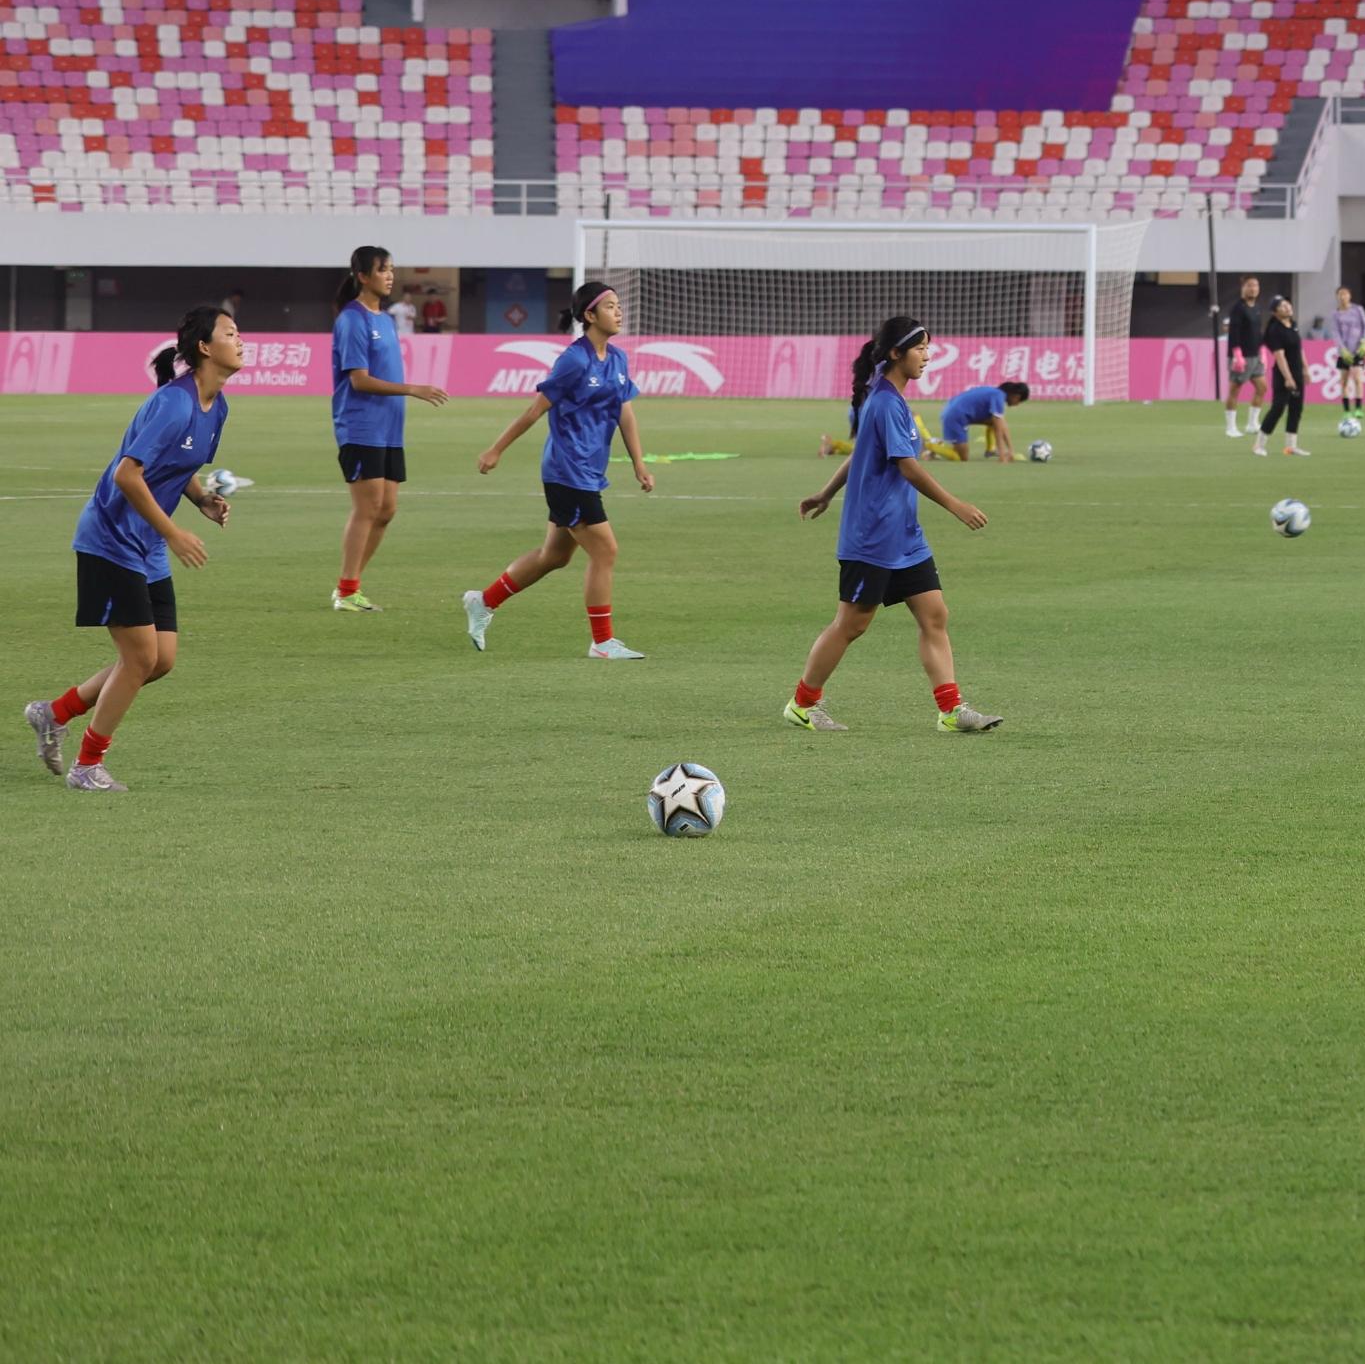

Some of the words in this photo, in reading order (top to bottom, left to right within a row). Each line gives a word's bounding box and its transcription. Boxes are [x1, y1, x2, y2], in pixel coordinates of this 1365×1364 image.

[241, 341, 312, 368] 国移动
[255, 370, 309, 386] Mobile
